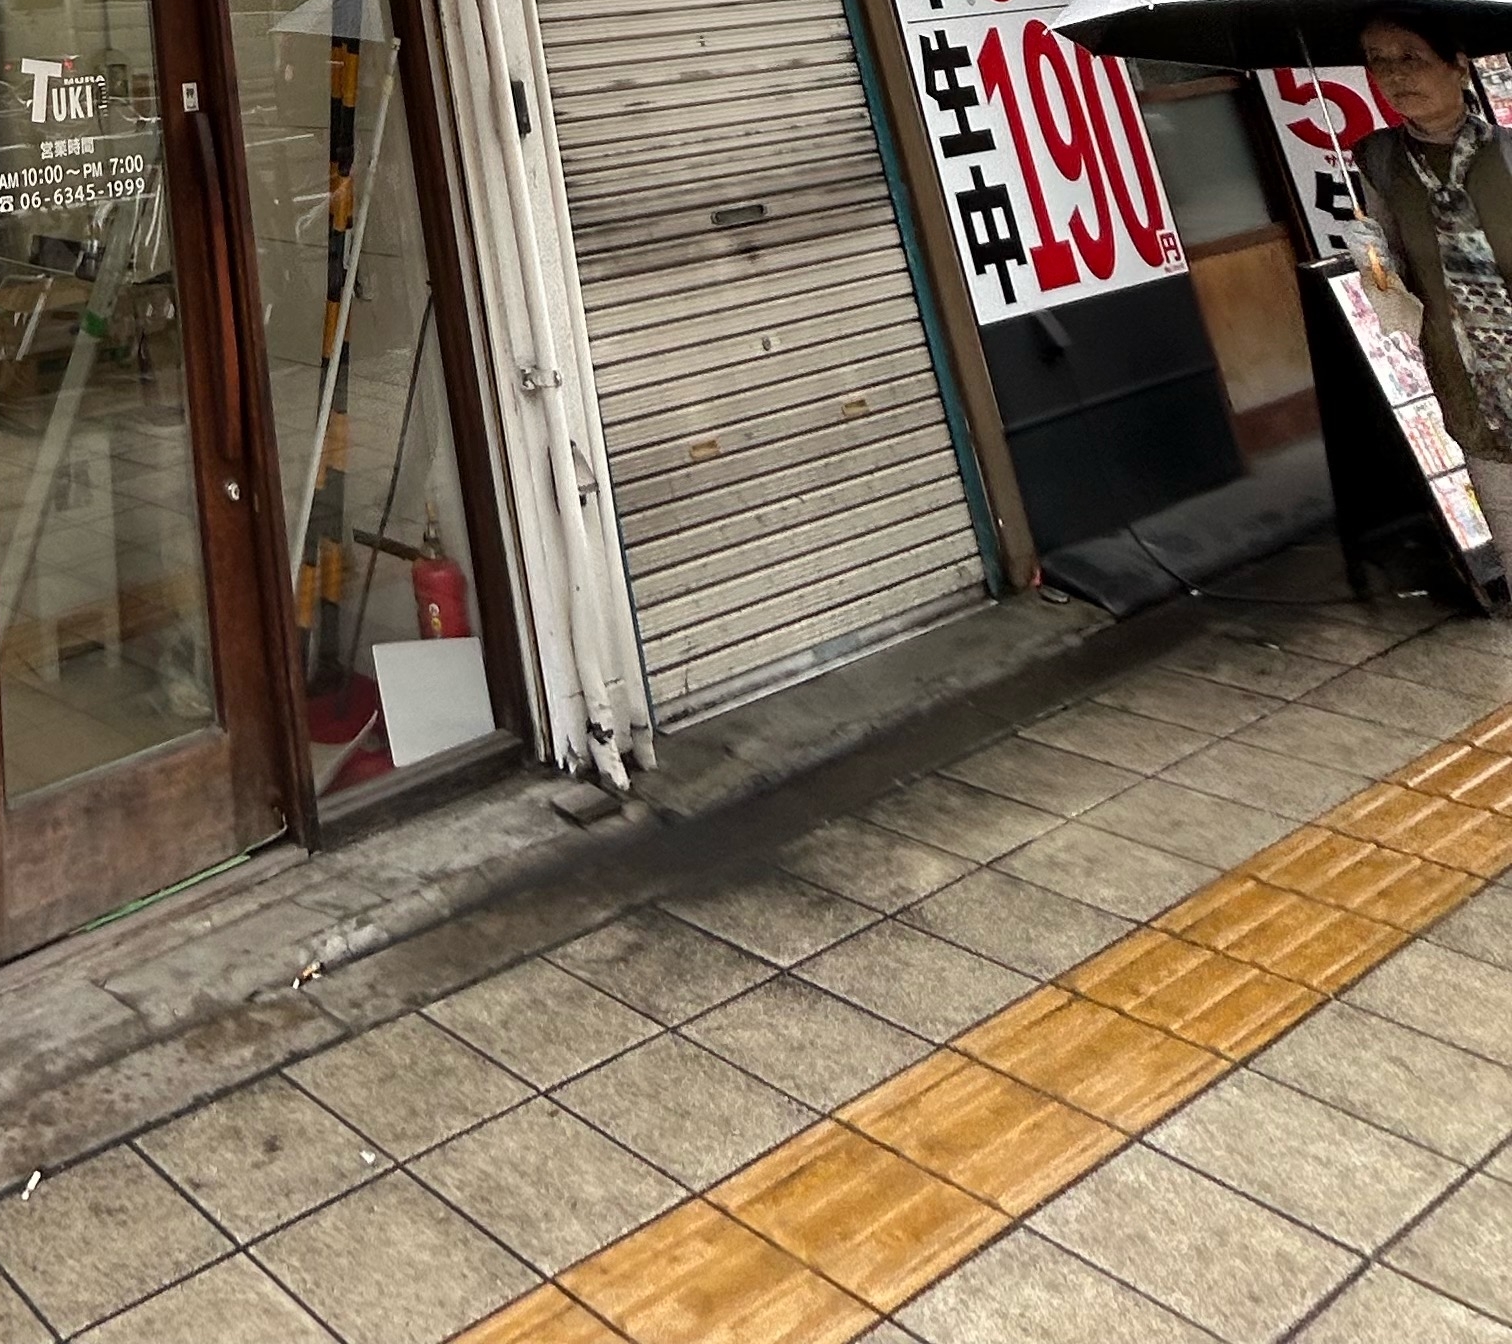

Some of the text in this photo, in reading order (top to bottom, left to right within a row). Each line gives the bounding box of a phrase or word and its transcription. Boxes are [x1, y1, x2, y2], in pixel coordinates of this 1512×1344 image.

[40, 137, 95, 160] 営業時間
[109, 154, 144, 176] 7:00
[919, 29, 1028, 304] 生中
[20, 177, 146, 210] 06-6345-1999
